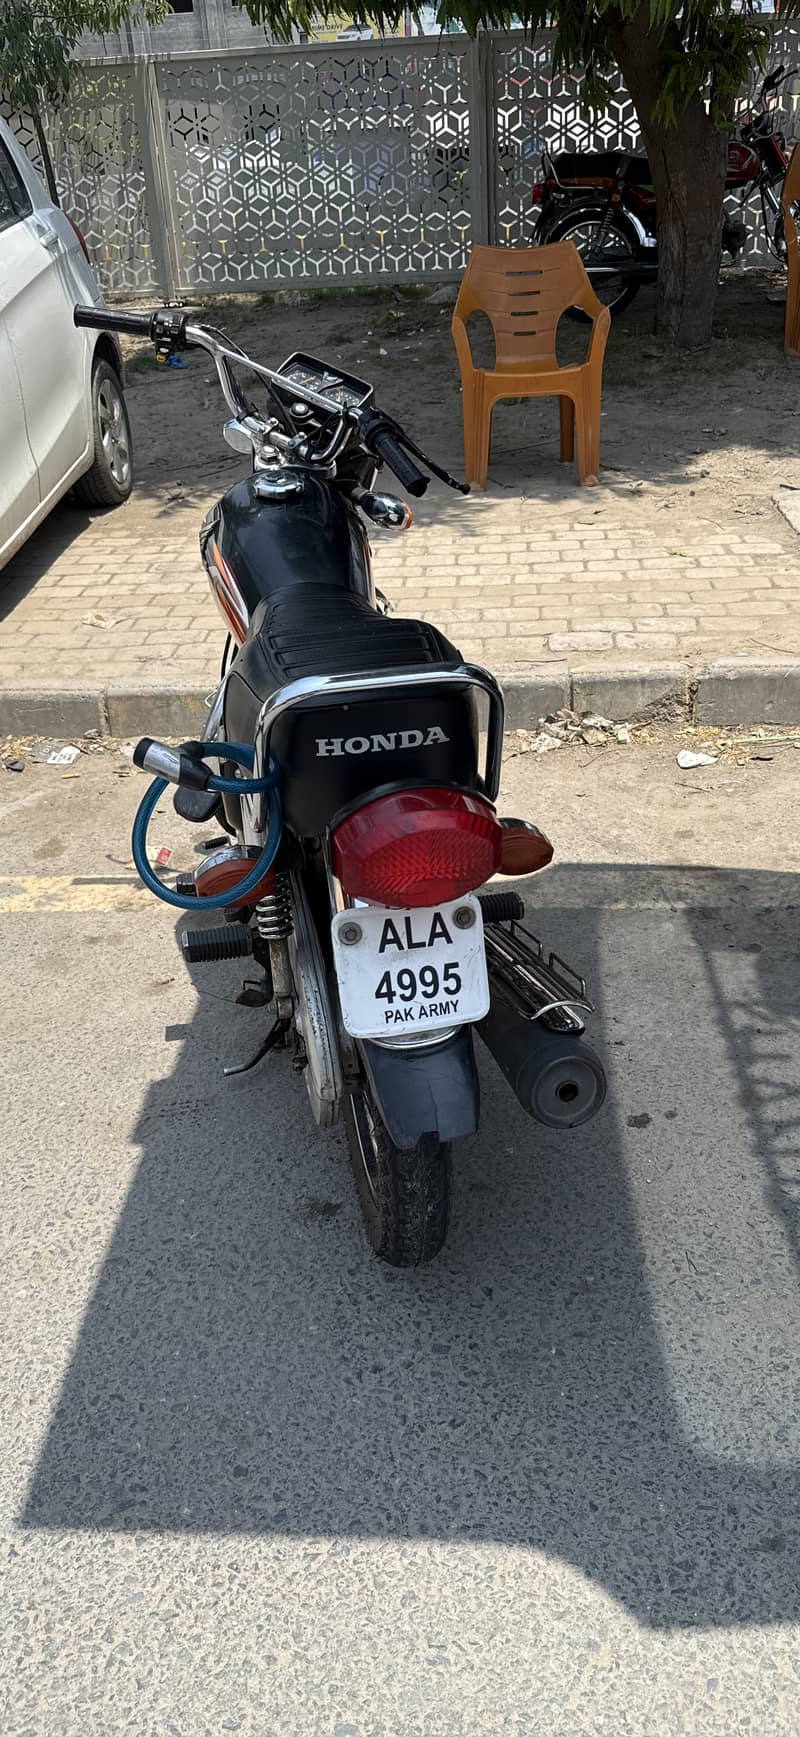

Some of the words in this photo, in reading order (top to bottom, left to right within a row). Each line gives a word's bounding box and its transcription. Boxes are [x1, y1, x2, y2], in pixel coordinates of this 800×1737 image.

[315, 726, 450, 757] HONDA
[378, 912, 453, 954] ALA
[374, 962, 462, 1004] 4995
[384, 1007, 414, 1024] PAK
[418, 999, 459, 1020] ARMY
